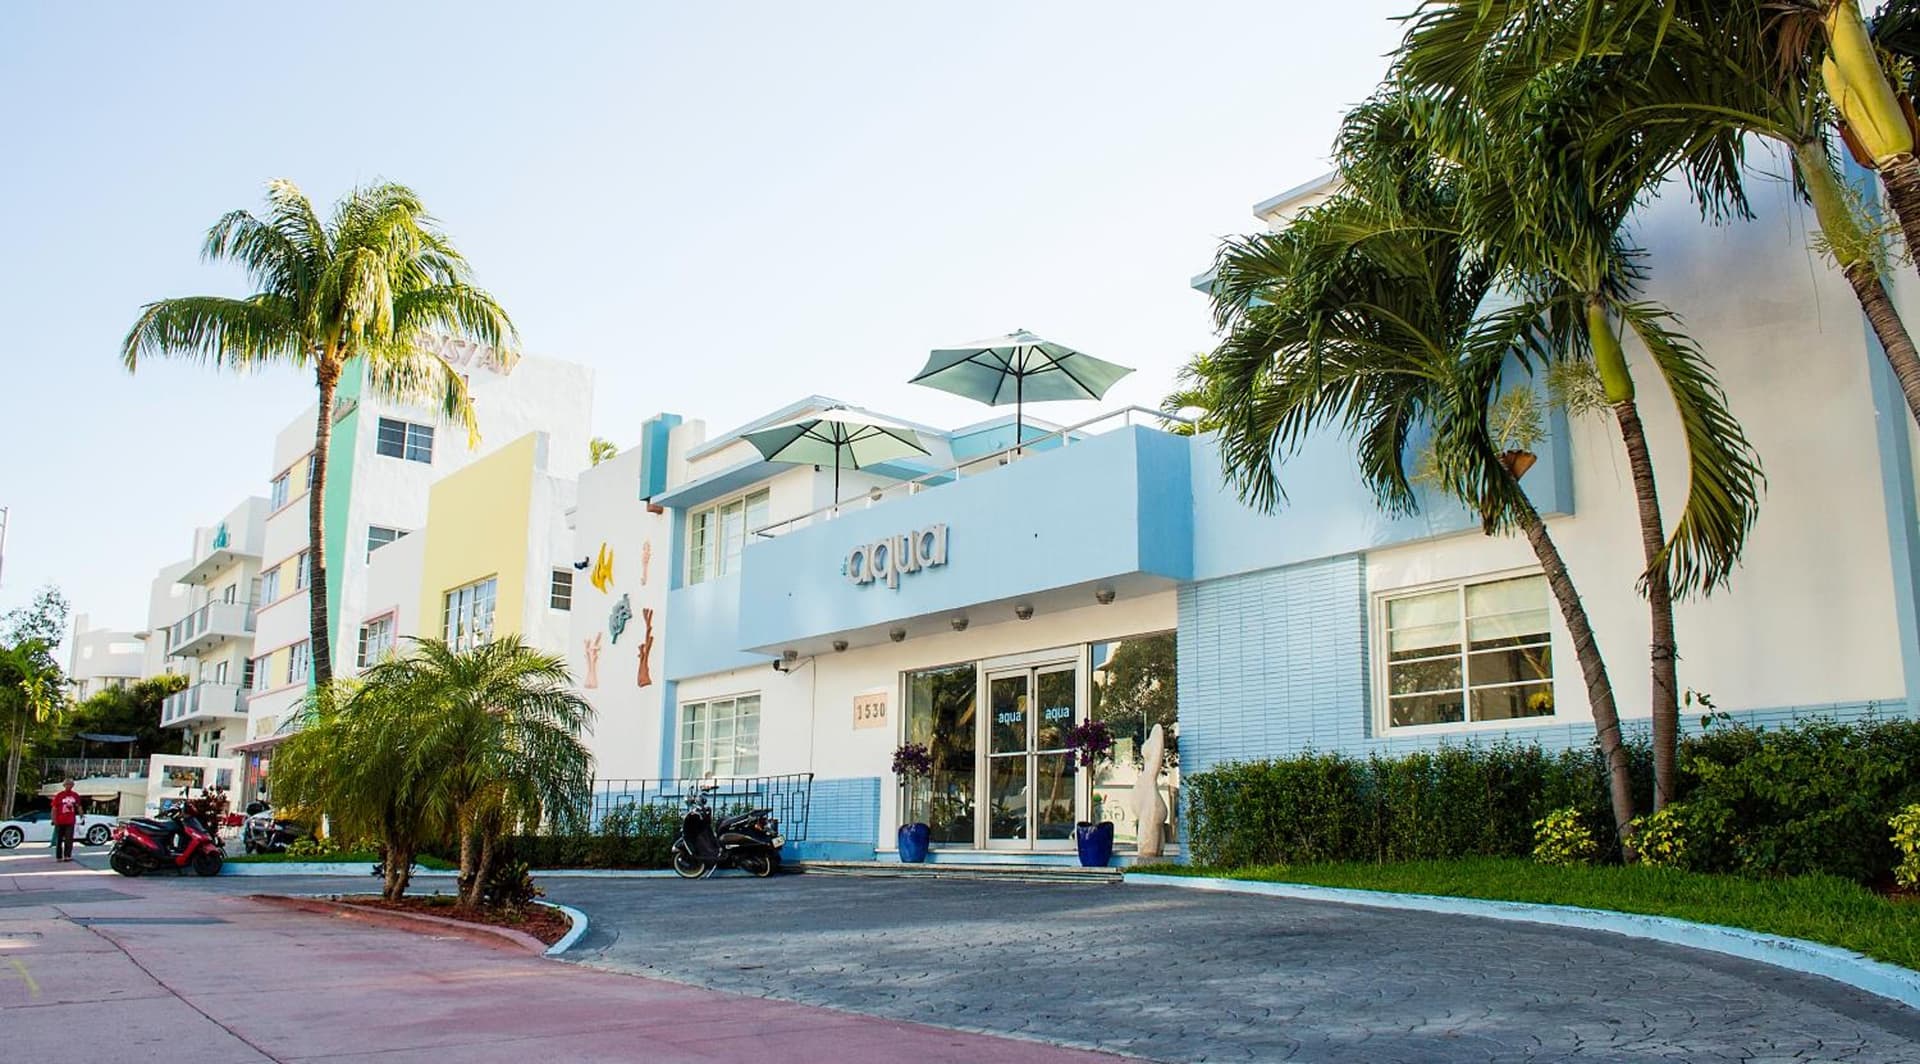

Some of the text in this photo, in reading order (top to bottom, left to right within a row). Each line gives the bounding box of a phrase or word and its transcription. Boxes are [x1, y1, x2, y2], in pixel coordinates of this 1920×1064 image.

[847, 523, 948, 589] aqua
[857, 702, 886, 720] 1530
[998, 711, 1022, 726] aqua
[1045, 706, 1070, 722] aqua
